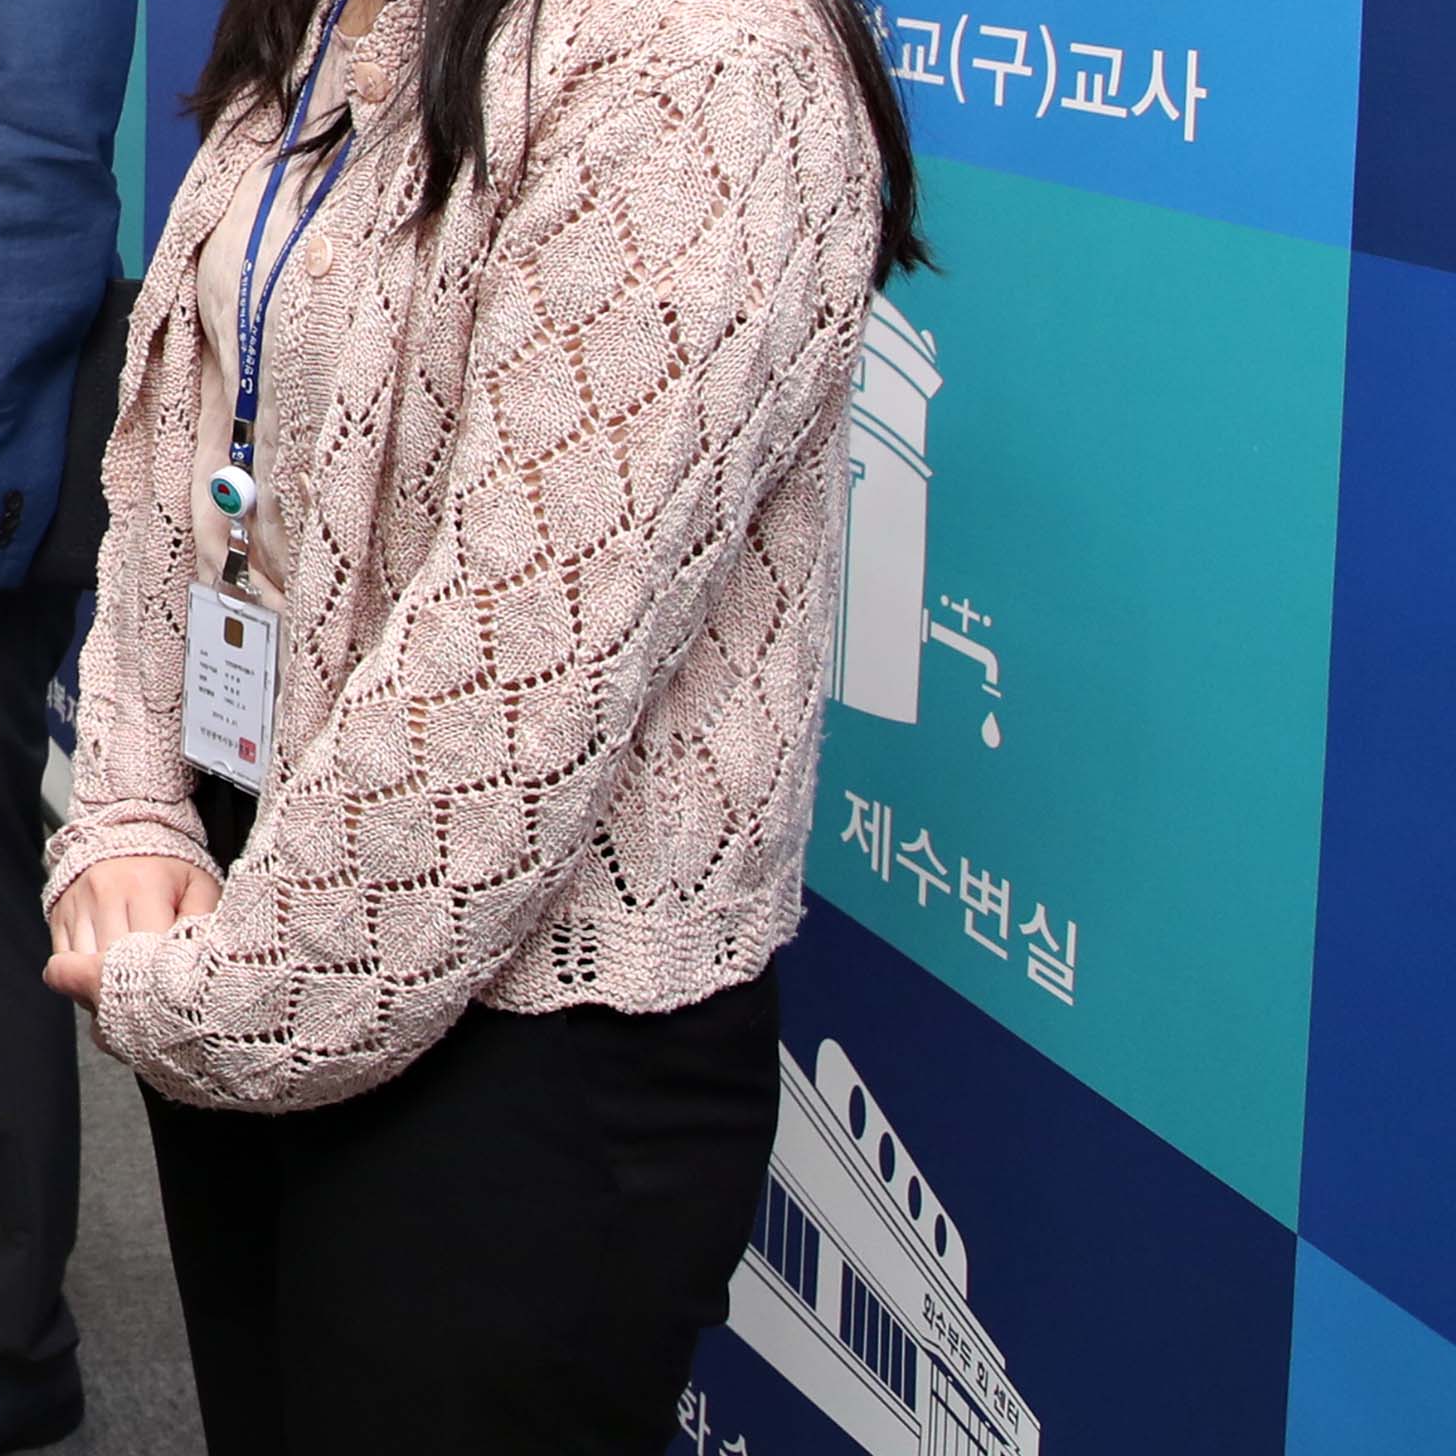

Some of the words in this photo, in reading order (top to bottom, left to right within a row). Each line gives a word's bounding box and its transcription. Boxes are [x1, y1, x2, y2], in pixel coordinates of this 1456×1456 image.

[840, 789, 1077, 1007] 제수변실
[922, 1293, 972, 1372] 화수부두
[994, 1384, 1020, 1434] 센터
